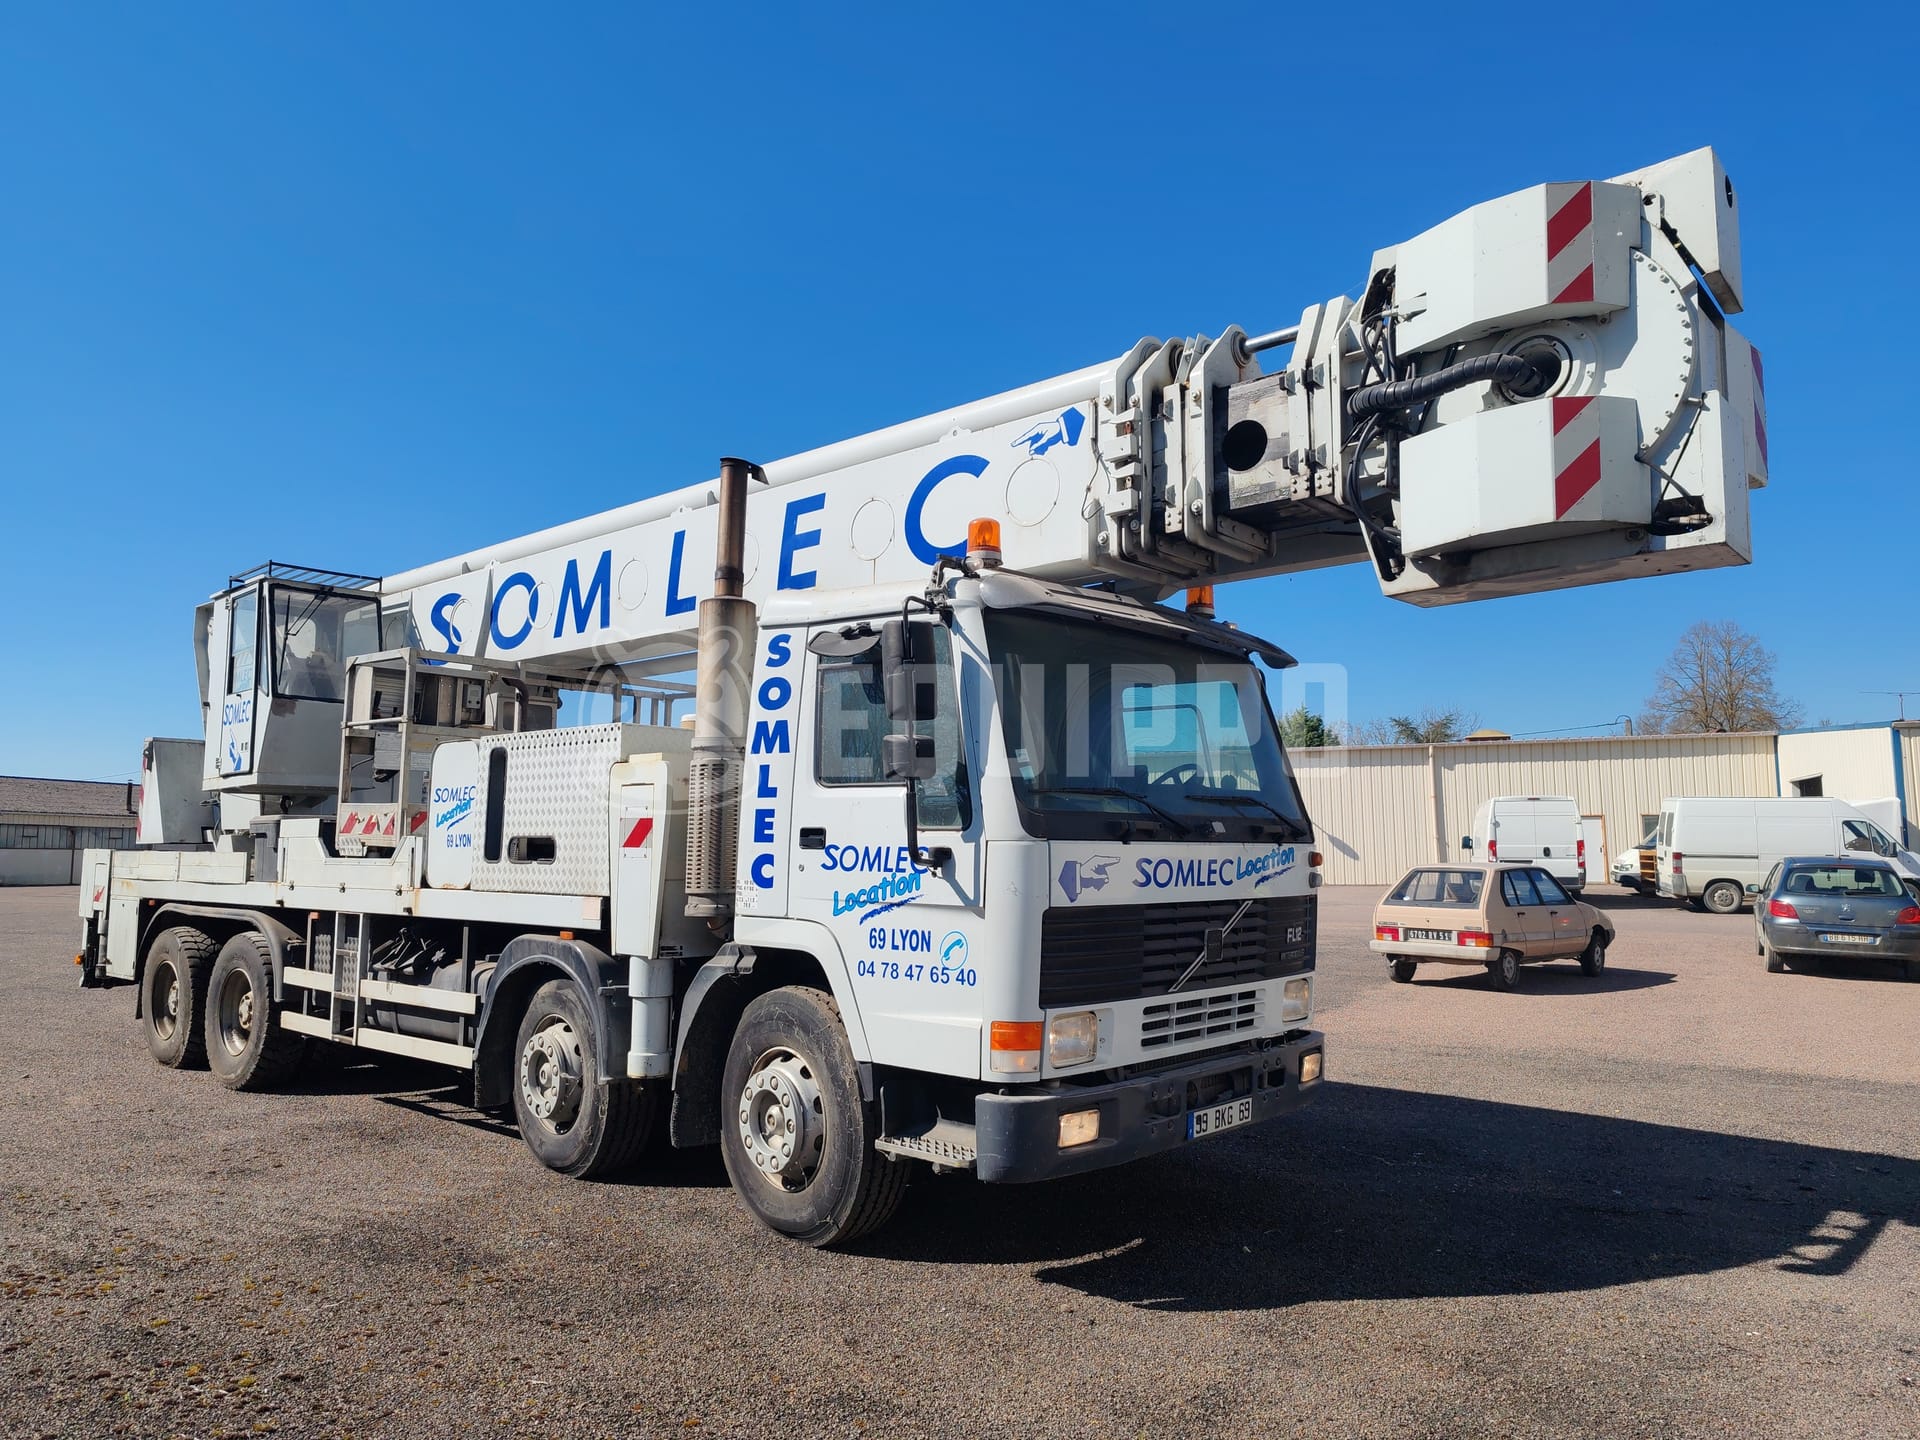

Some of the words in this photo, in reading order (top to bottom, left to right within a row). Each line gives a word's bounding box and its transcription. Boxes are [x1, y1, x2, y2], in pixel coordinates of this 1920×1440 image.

[423, 455, 991, 665] SOMLEC
[223, 700, 251, 726] SOMLEC
[750, 633, 792, 889] SOMLEC
[433, 785, 476, 803] SOMLEC
[435, 800, 472, 828] Location
[446, 834, 454, 848] 69
[455, 833, 472, 848] LYON
[820, 844, 929, 874] SOMLEC
[1132, 857, 1234, 888] SOMLEC
[1236, 846, 1295, 881] Location
[832, 872, 921, 917] Location
[869, 927, 886, 950] 69
[891, 928, 932, 953] LYON
[857, 959, 876, 977] 04
[881, 961, 900, 980] 78
[904, 963, 924, 982] 47
[929, 966, 950, 985] 65
[955, 968, 977, 987] 40
[1215, 1105, 1233, 1130] BKG
[1239, 1101, 1251, 1122] 69
